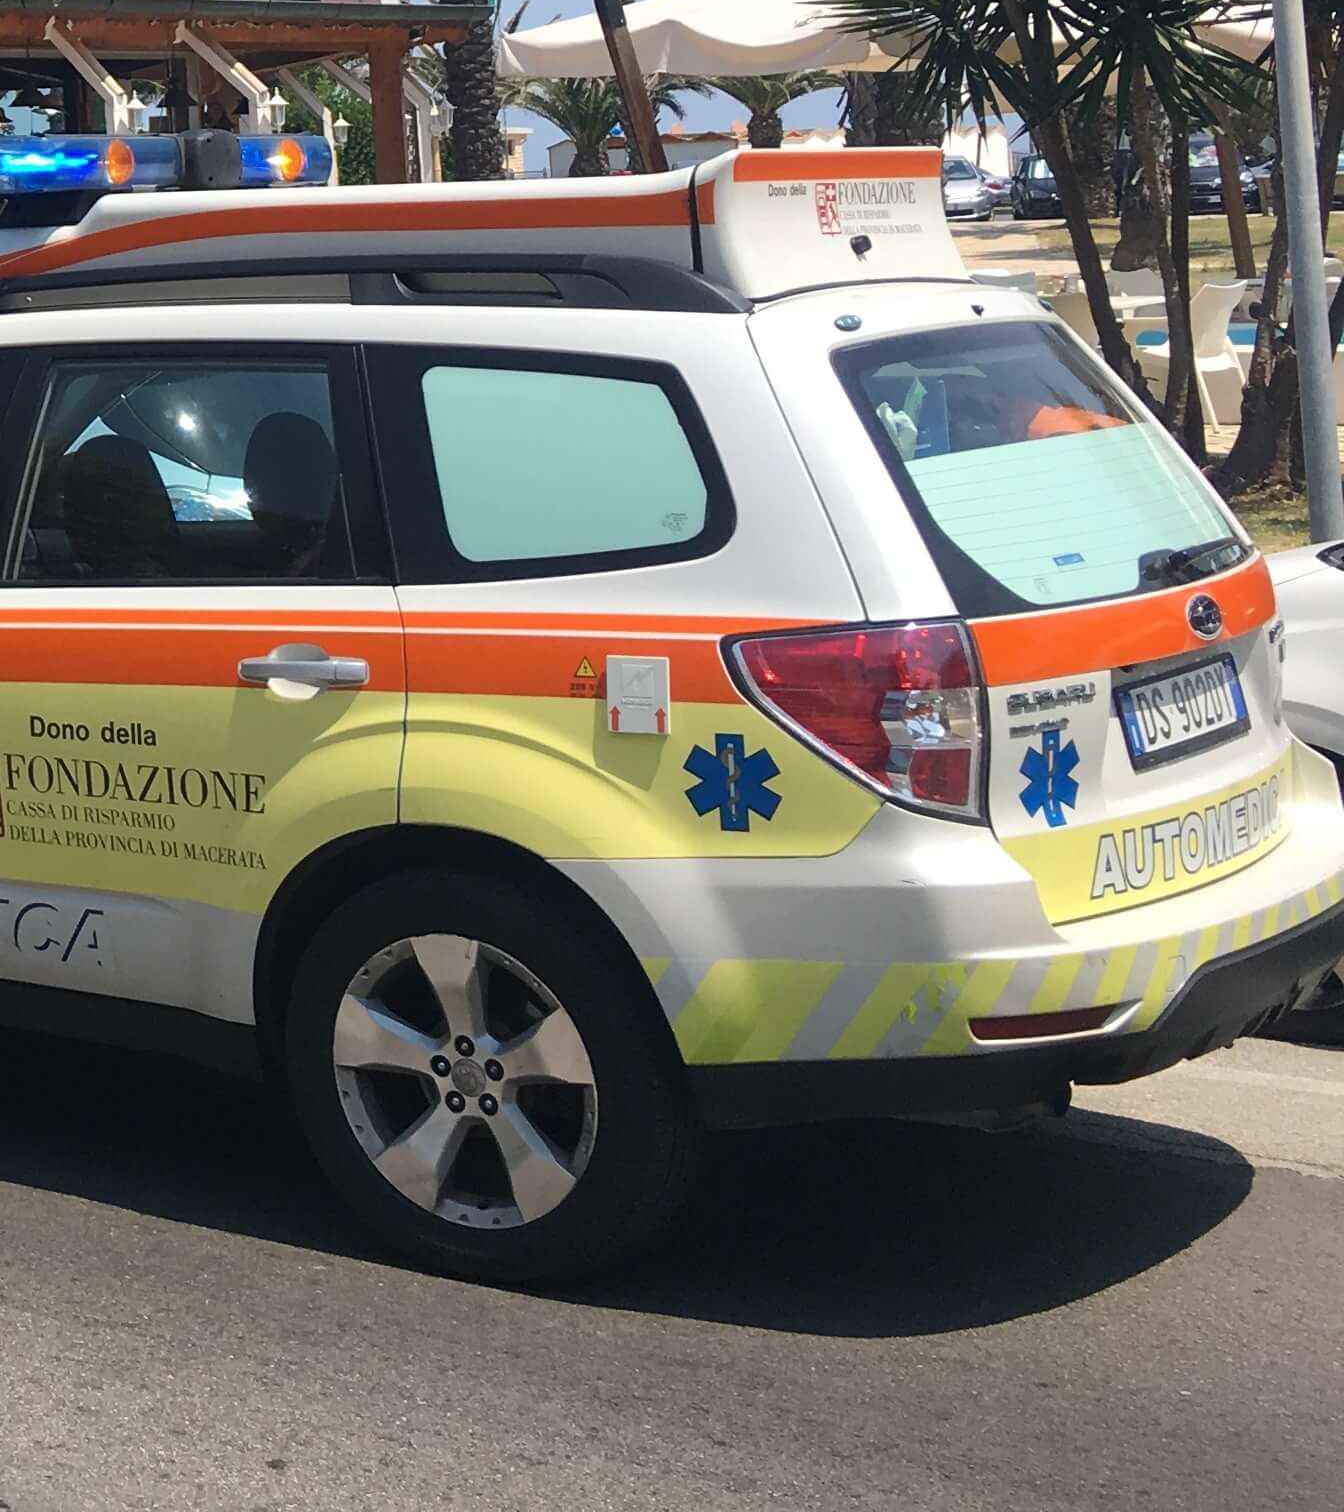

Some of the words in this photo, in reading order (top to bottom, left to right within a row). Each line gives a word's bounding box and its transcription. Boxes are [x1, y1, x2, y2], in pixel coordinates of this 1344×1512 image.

[838, 182, 916, 205] FONDAZIONE
[29, 715, 90, 741] Dono
[101, 721, 157, 747] della
[1136, 691, 1172, 745] DS
[3, 752, 266, 815] FONDAZIONE
[7, 799, 57, 819] CASSA
[62, 804, 79, 822] DI
[84, 807, 175, 831] RISPARMIO
[1090, 772, 1282, 900] AUTOMEDIC
[10, 825, 60, 845] DELLA
[66, 830, 156, 856] PROVINCIA
[161, 841, 179, 858] DI
[184, 843, 267, 870] MACERATA
